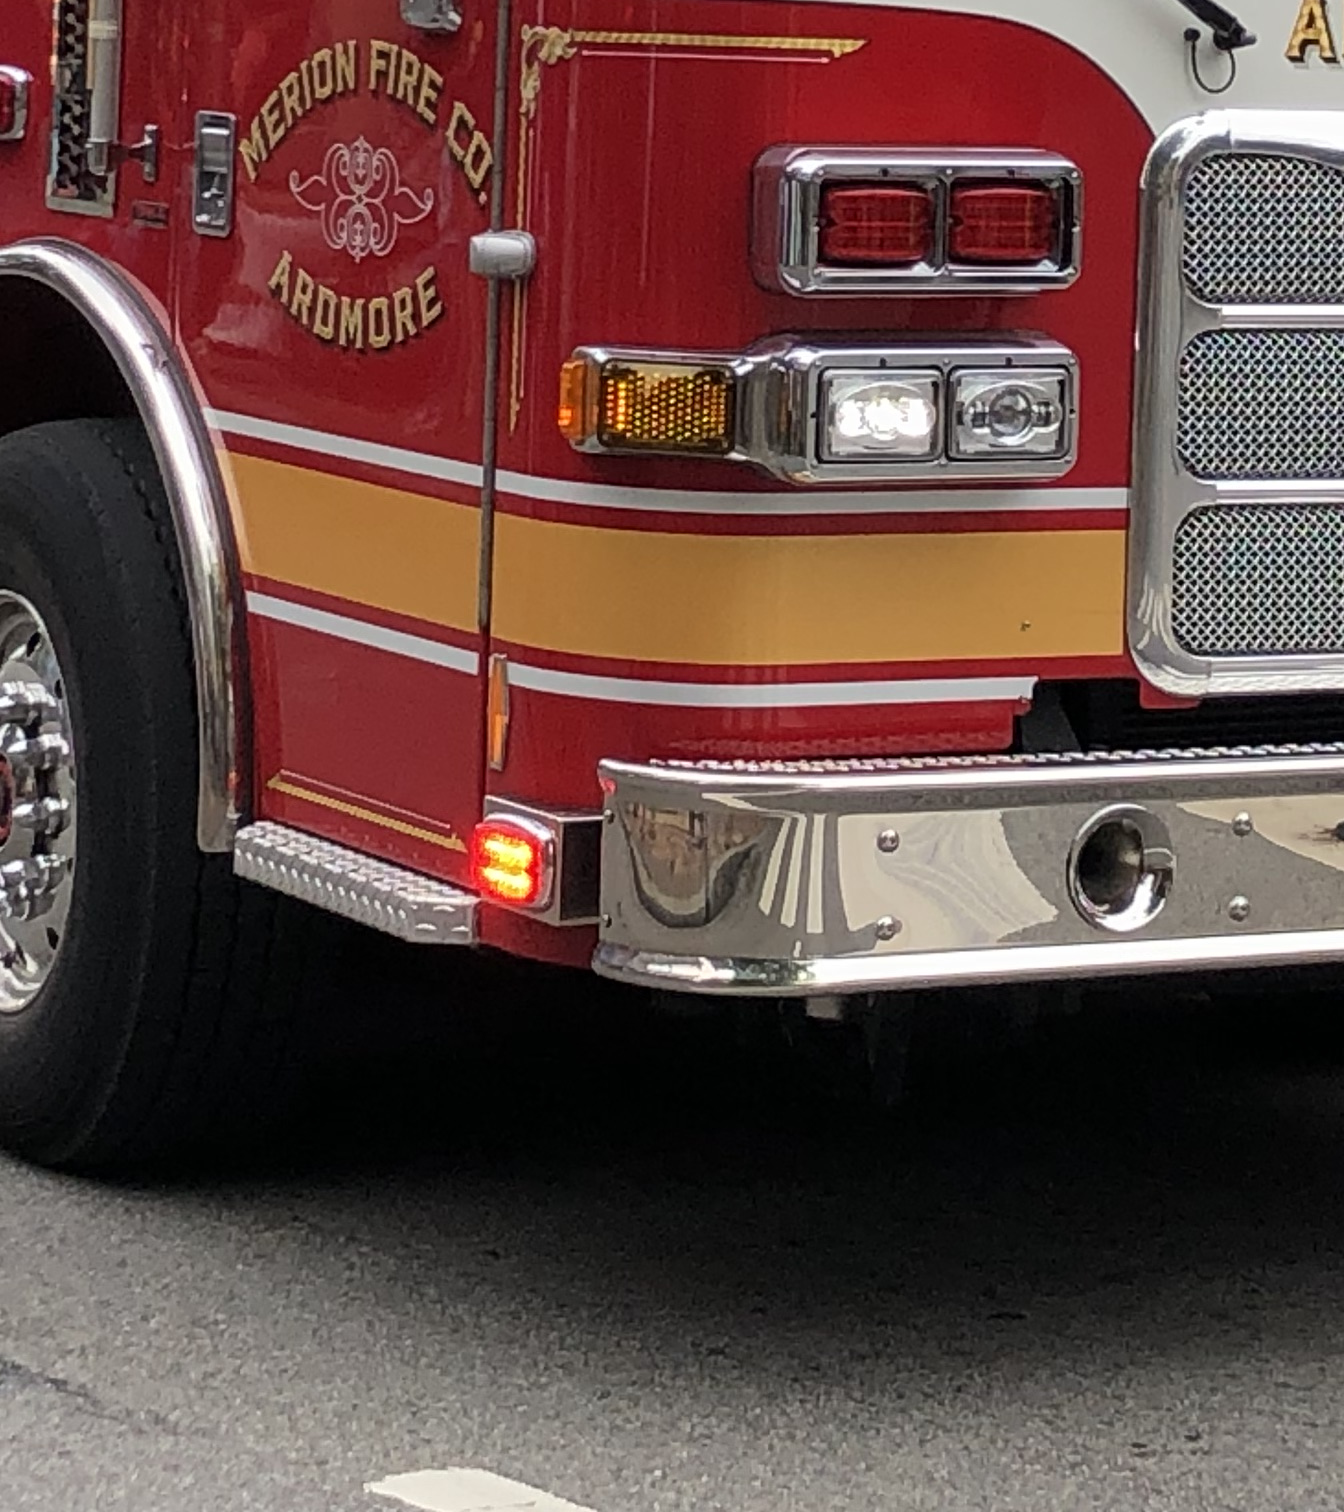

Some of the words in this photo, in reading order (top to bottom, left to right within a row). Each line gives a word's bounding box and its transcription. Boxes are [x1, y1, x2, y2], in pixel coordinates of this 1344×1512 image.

[238, 39, 358, 184] MERION
[368, 38, 445, 126] FIRE
[445, 101, 494, 207] CO.
[267, 250, 445, 350] ARDMORE
